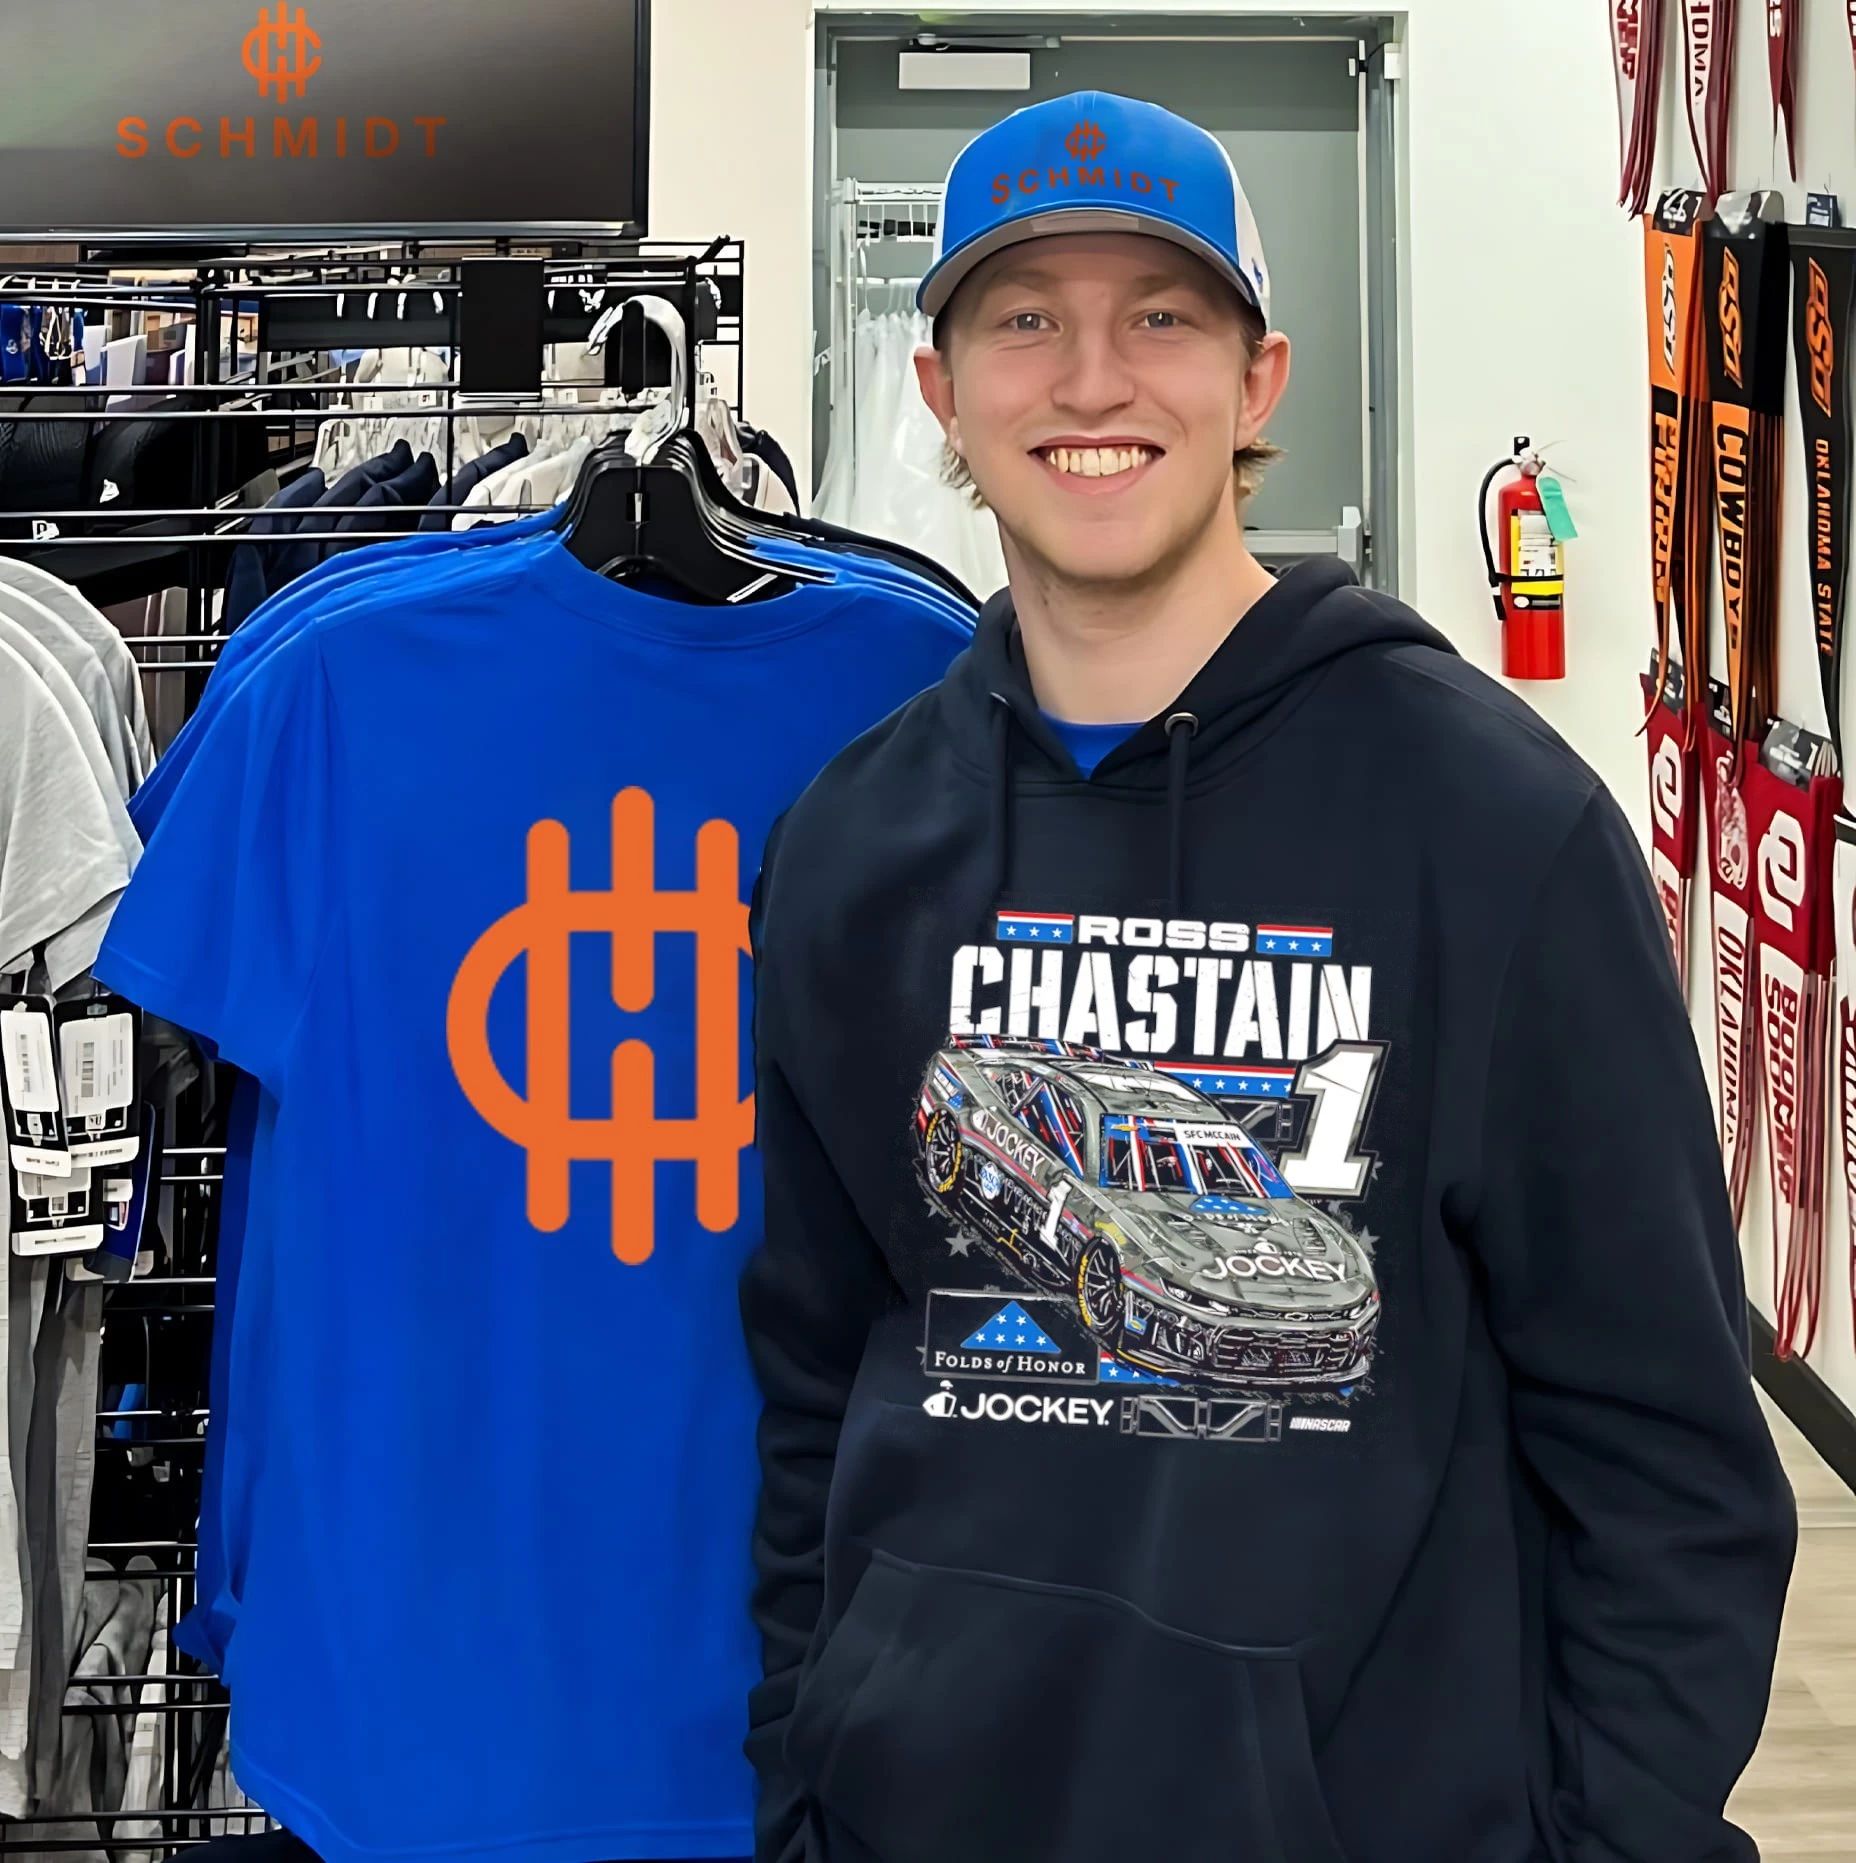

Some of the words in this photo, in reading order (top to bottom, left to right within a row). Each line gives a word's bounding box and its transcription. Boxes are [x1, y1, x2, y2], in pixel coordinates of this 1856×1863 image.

[116, 116, 447, 158] SCHMIDT
[992, 166, 1180, 204] SCHMIDT
[1717, 424, 1747, 649] COWBOY
[1078, 915, 1250, 952] ROSS
[950, 945, 1372, 1060] CHASTAIN
[1283, 1050, 1375, 1190] 1
[986, 1121, 1045, 1177] JOCKEY
[1202, 1255, 1347, 1283] JOCKEY
[934, 1351, 992, 1369] FOLDS
[997, 1355, 1014, 1373] of
[1017, 1356, 1086, 1374] HONOR
[1304, 1417, 1351, 1432] NASCAR
